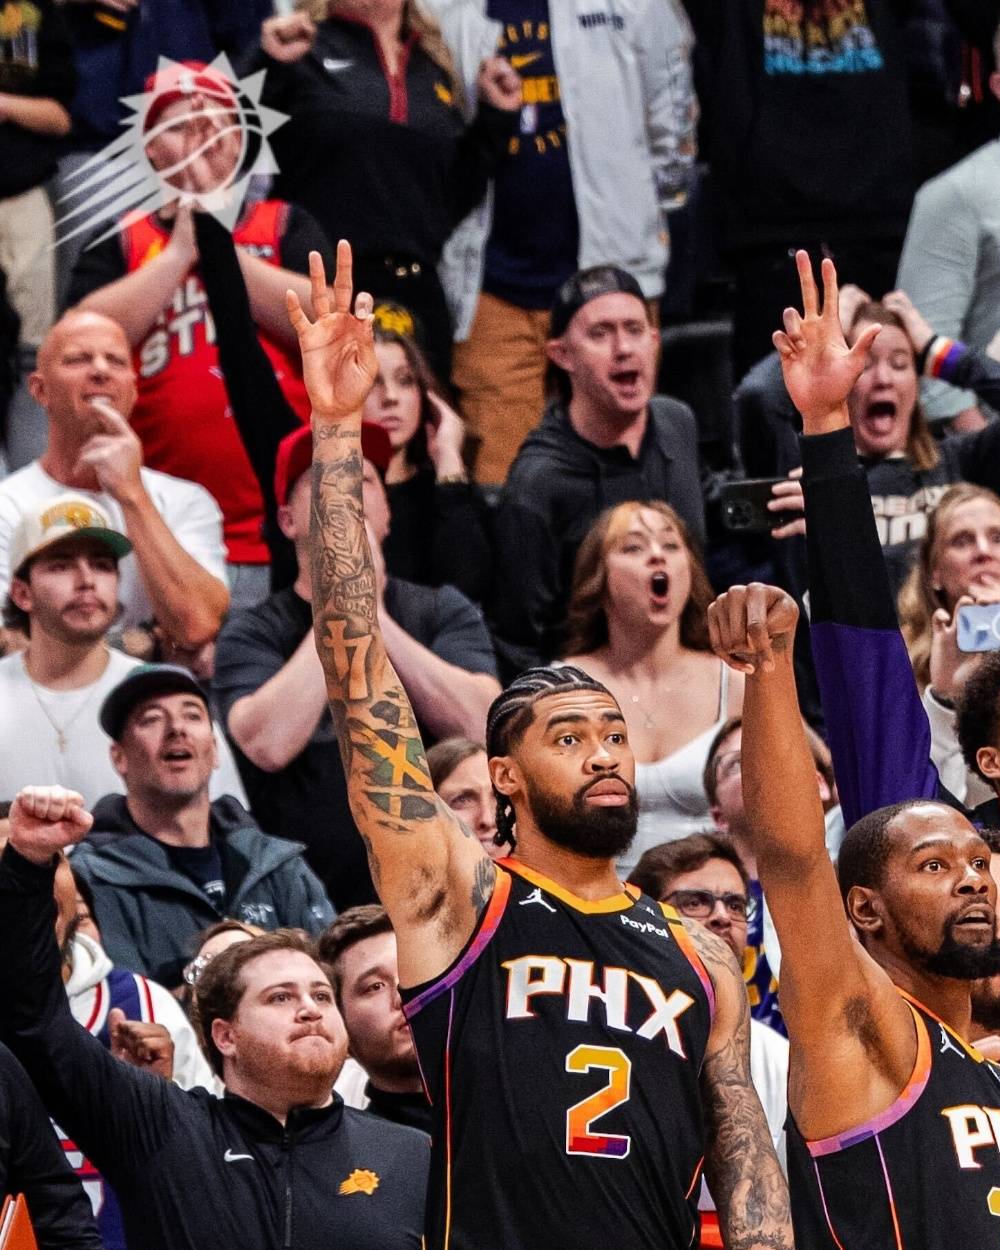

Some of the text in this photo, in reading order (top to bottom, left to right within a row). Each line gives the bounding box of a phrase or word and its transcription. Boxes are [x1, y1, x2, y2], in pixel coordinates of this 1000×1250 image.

[620, 914, 669, 938] PayPal
[501, 955, 695, 1060] PHX
[565, 1044, 631, 1159] 2
